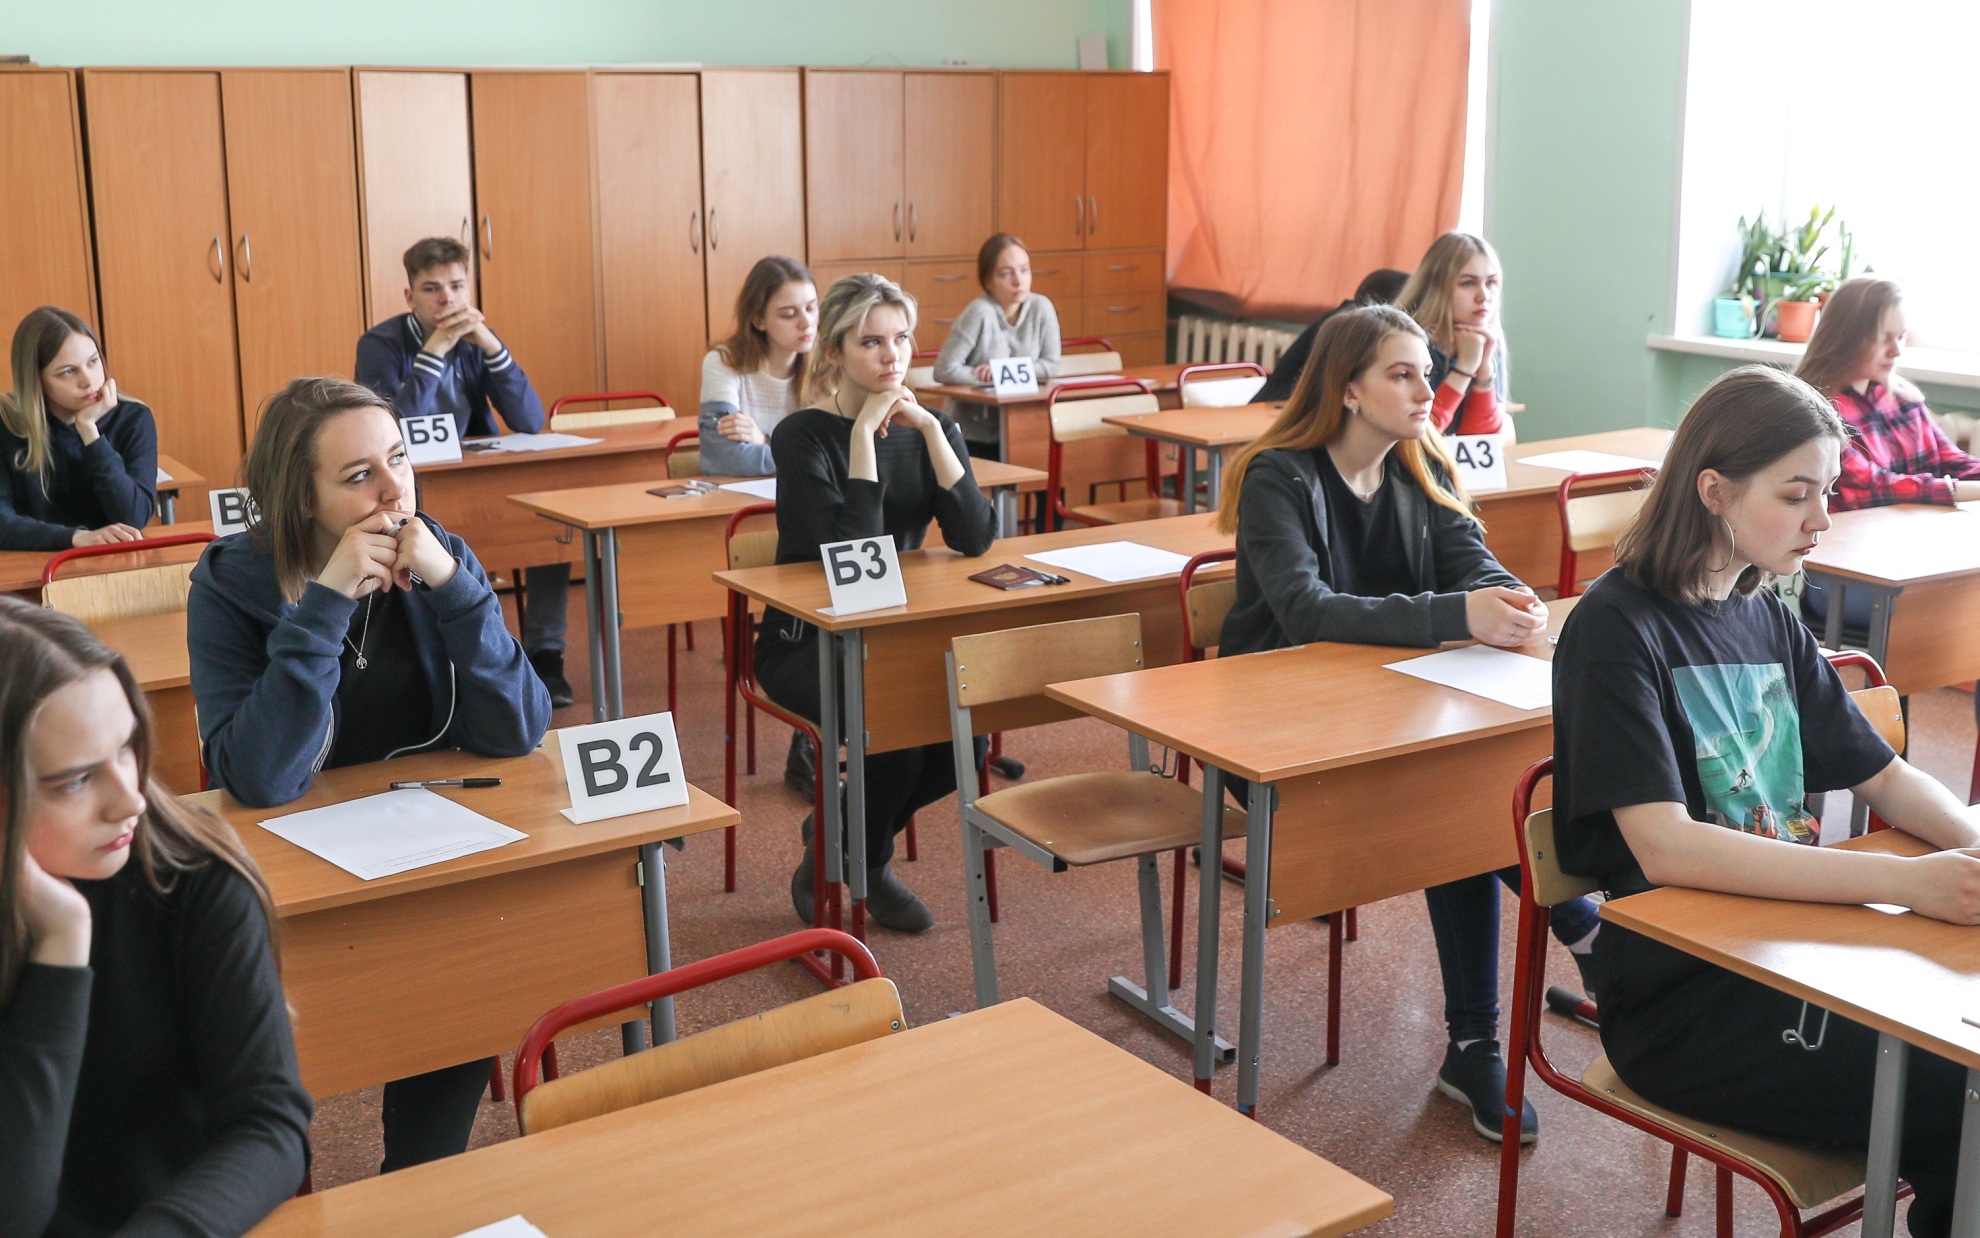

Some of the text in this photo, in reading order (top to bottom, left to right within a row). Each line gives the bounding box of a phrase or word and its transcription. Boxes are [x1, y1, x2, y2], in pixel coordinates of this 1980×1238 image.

[1000, 364, 1030, 385] А5
[406, 417, 449, 445] Б5
[1455, 440, 1494, 469] А3
[828, 540, 887, 586] Б3
[577, 731, 671, 797] В2
